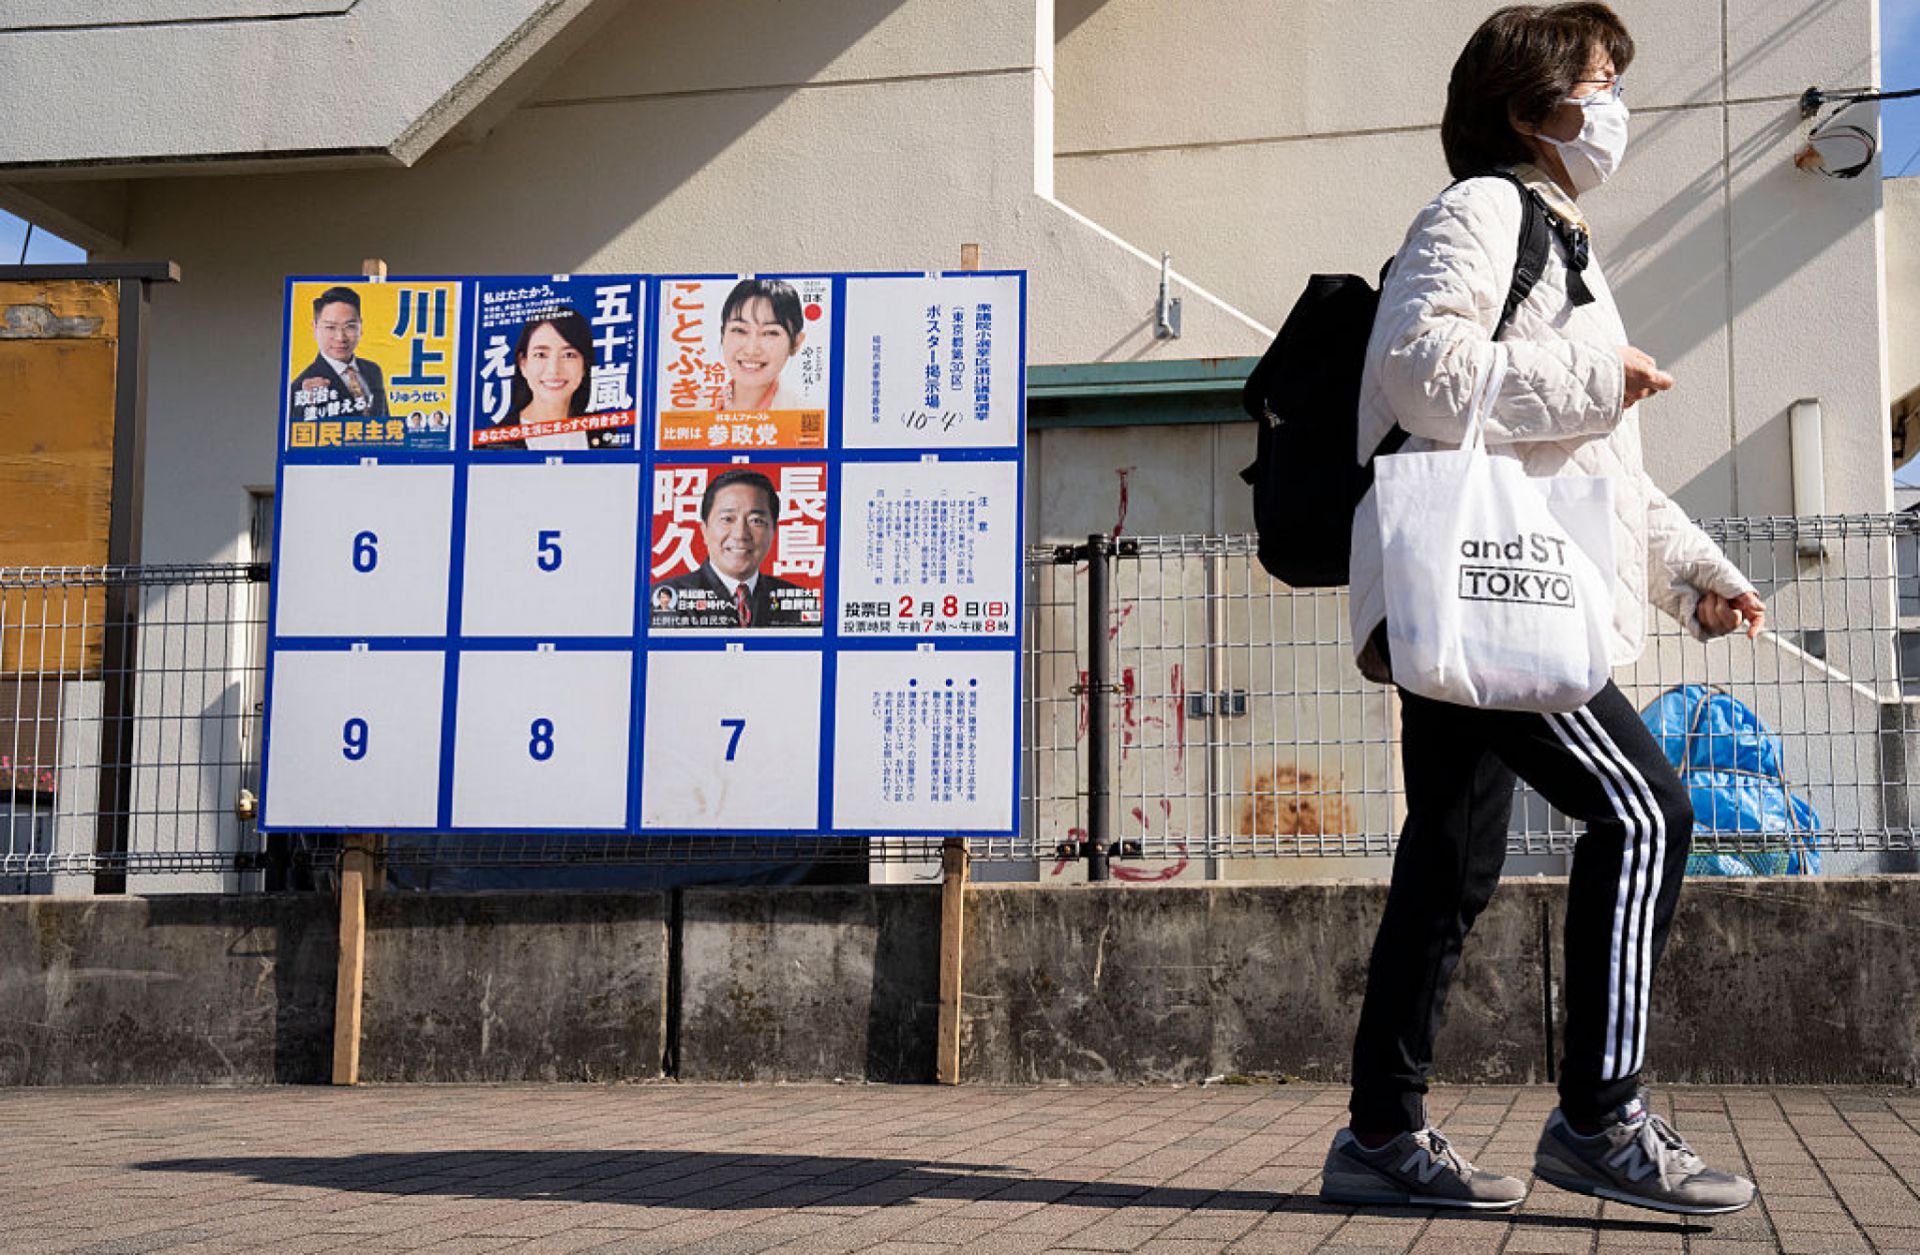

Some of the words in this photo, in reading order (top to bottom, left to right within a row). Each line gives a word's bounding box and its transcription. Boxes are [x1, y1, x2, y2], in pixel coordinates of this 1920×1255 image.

[391, 288, 447, 386] 川上
[585, 284, 634, 413] 五十嵐
[667, 283, 706, 409] ことぶき
[925, 304, 941, 409] ポスター掲示場
[480, 335, 516, 425] えり
[703, 361, 726, 409] 玲子
[291, 420, 405, 447] 国民民主党
[707, 423, 778, 446] 参政党
[651, 468, 709, 578] 昭久
[773, 466, 827, 577] 長島
[352, 530, 378, 573] 6
[537, 530, 562, 572] 5
[1461, 534, 1523, 560] and
[1530, 532, 1566, 565] ST
[1466, 571, 1570, 601] TOKYO
[844, 620, 891, 633] 投票時間
[845, 602, 890, 618] 投票日
[342, 718, 368, 761] 9
[529, 718, 554, 761] 8
[720, 719, 746, 761] 7
